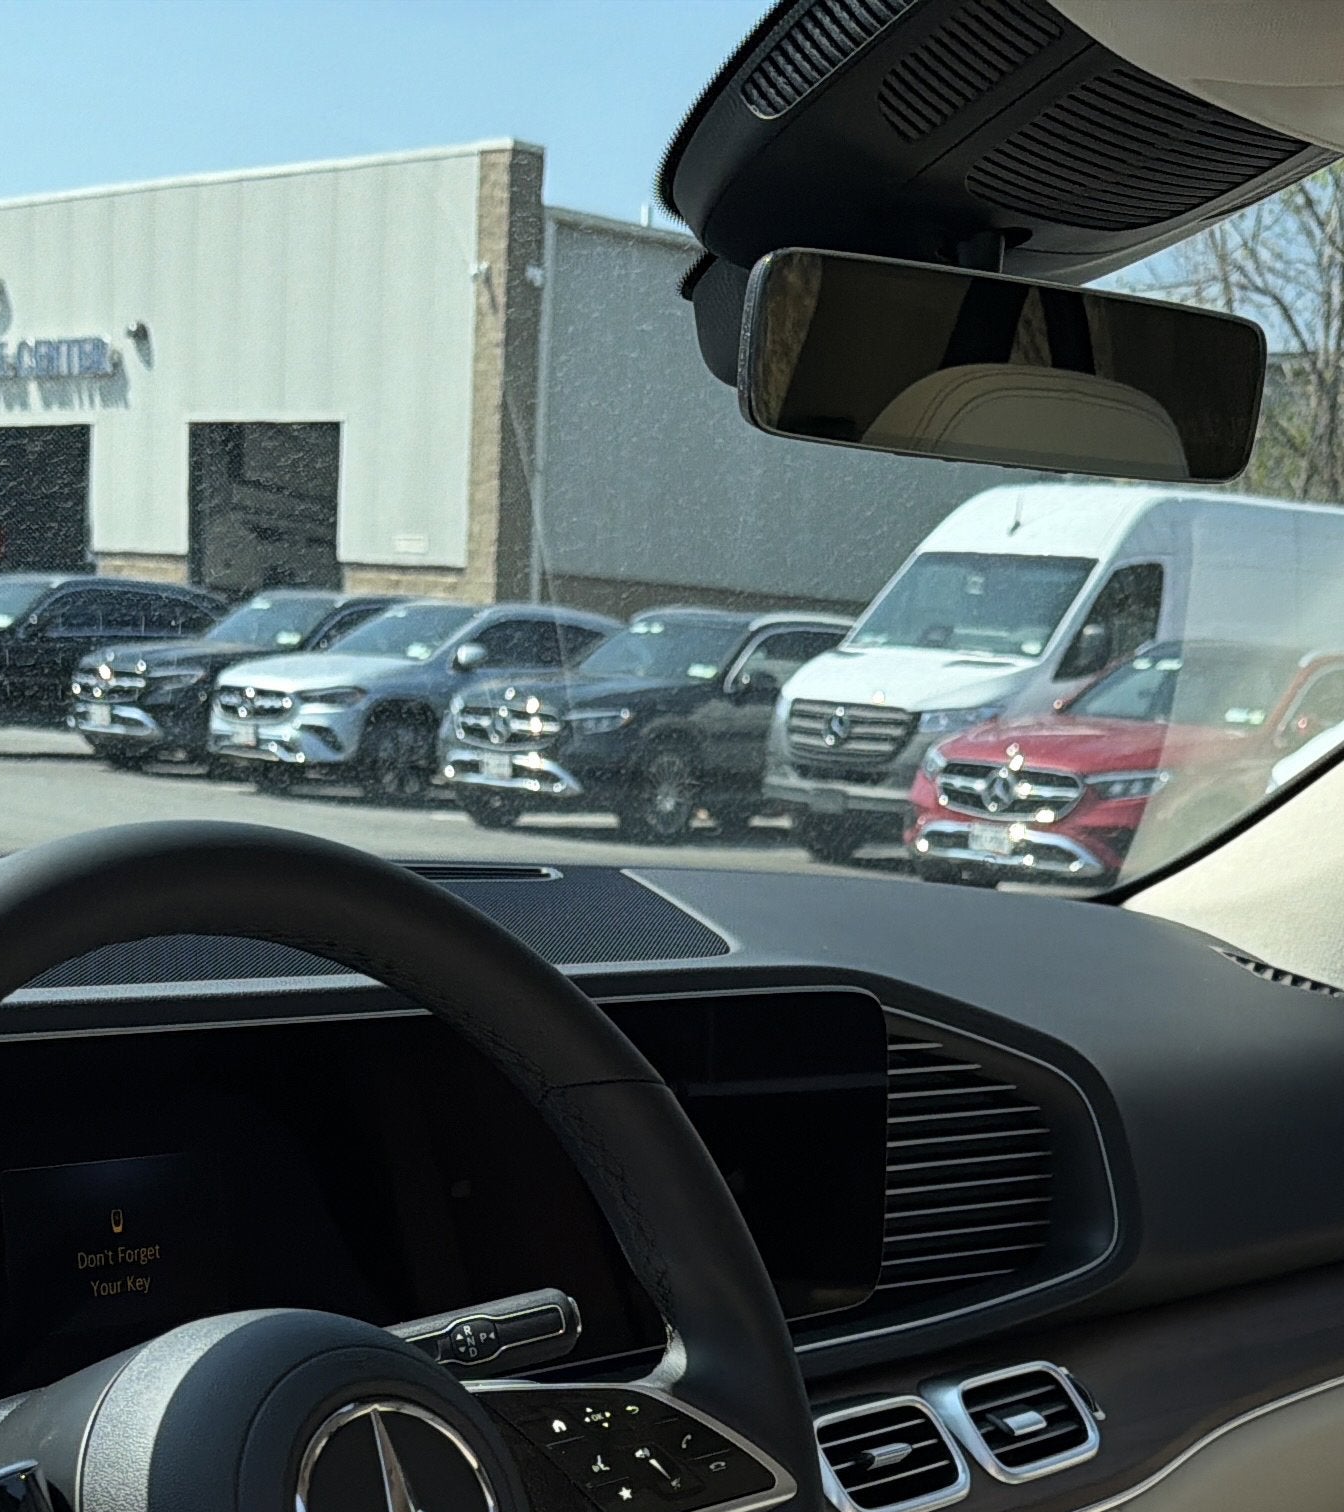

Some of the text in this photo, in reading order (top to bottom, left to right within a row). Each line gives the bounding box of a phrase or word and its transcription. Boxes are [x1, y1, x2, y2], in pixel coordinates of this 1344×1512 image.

[77, 1244, 161, 1270] Don't Forget
[90, 1275, 151, 1297] Your Key
[463, 1325, 472, 1336] R
[466, 1336, 476, 1346] N
[479, 1332, 488, 1343] P
[469, 1347, 478, 1358] D
